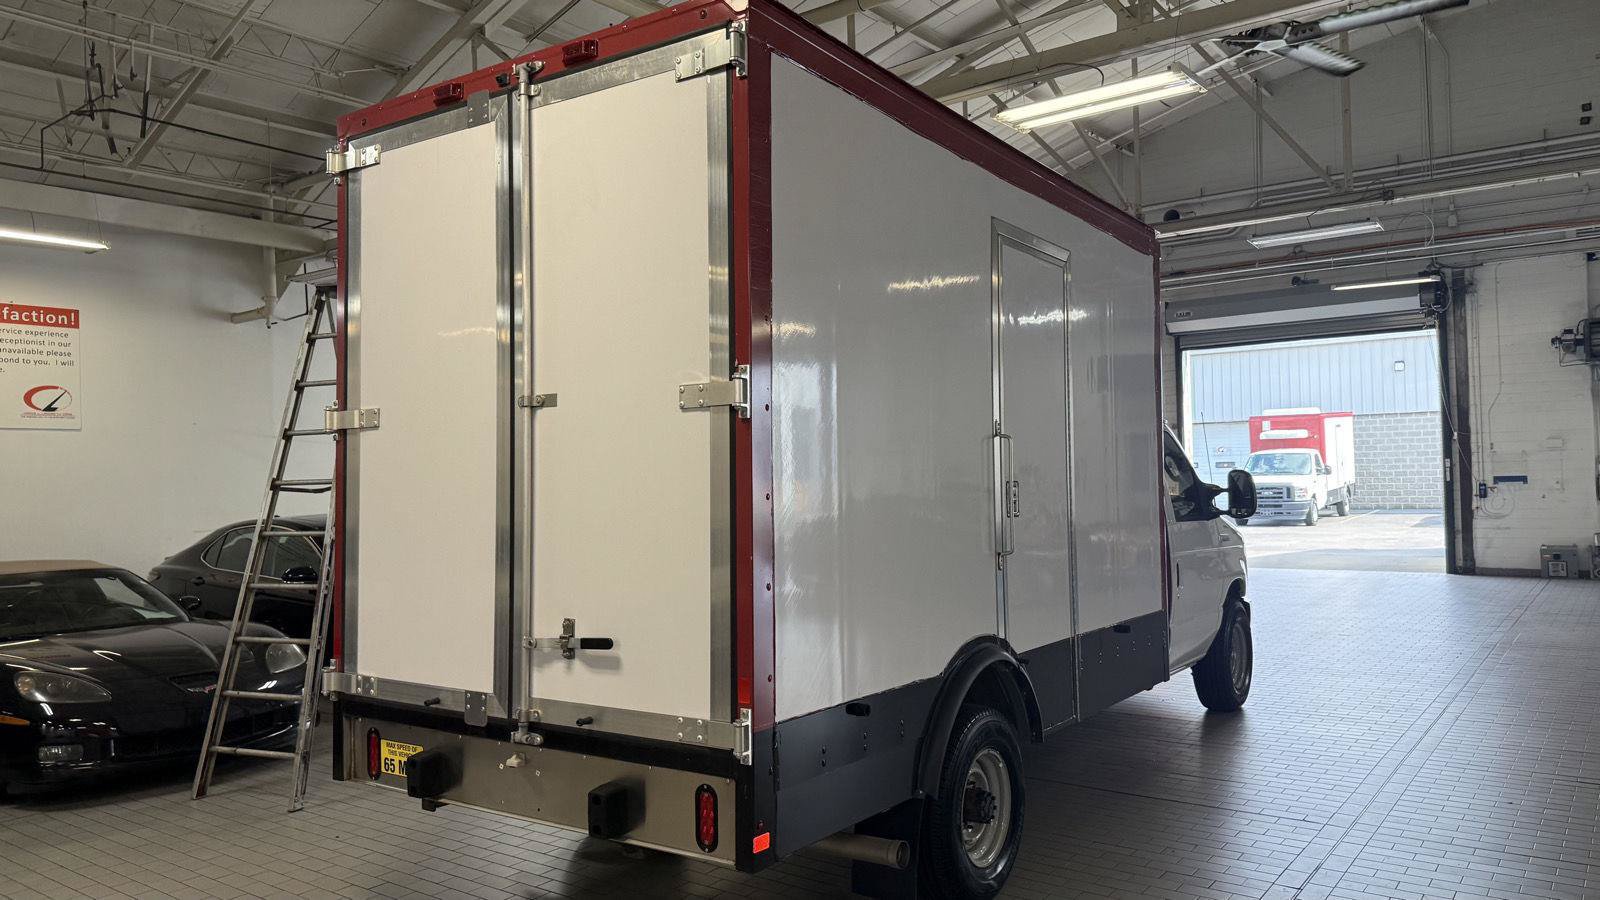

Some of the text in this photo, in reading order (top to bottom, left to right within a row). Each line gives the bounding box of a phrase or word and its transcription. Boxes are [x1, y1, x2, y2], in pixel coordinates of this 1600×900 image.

[2, 306, 75, 325] faction!
[0, 327, 69, 338] rvice experience
[0, 347, 72, 358] navailable please
[384, 757, 395, 773] 65
